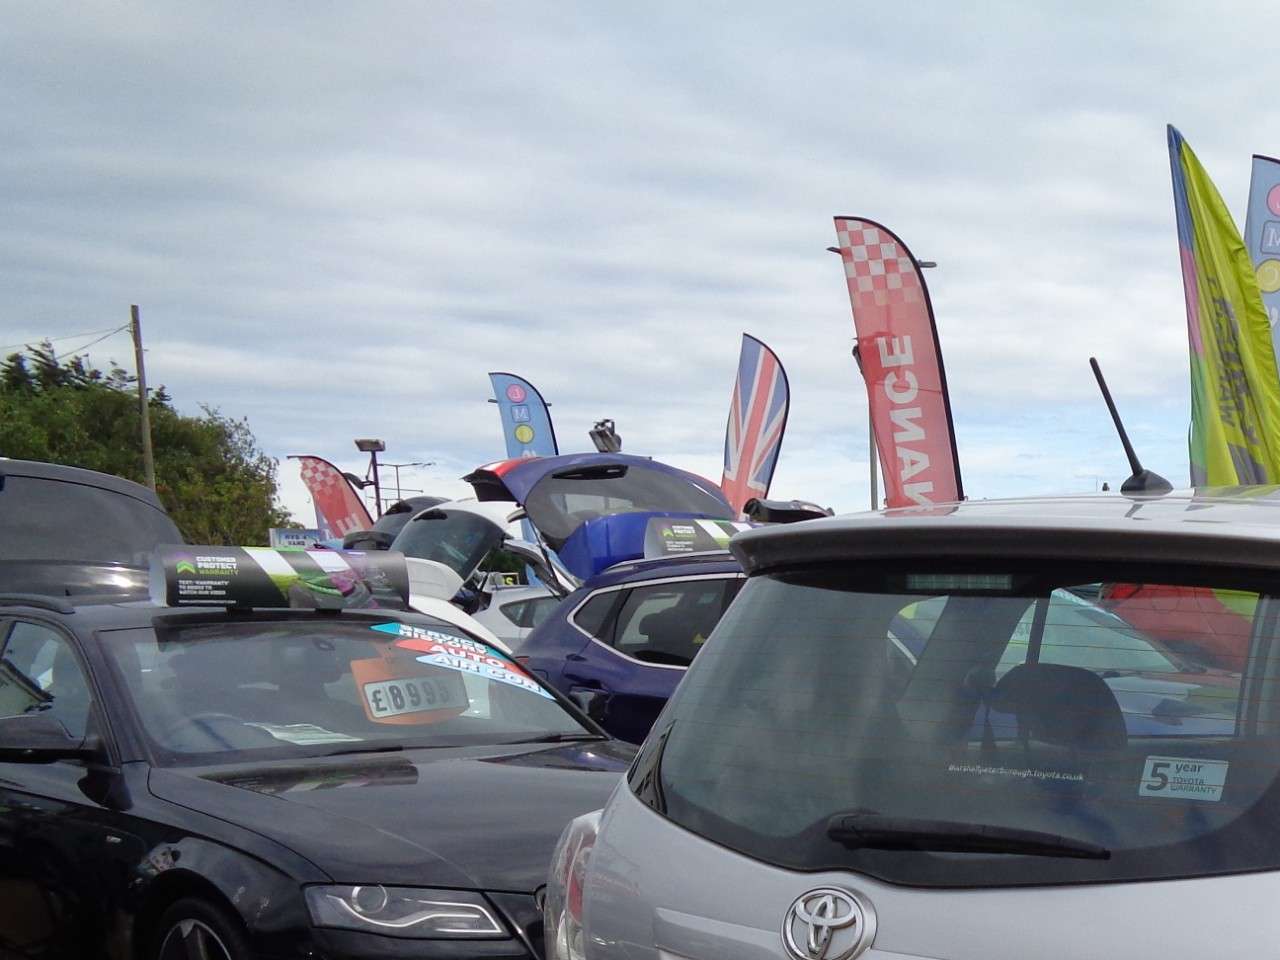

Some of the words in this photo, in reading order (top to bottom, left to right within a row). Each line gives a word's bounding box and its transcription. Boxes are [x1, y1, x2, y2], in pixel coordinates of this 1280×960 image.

[429, 644, 506, 669] AUTO
[434, 653, 481, 673] AIR
[1145, 762, 1170, 791] 5
[1175, 763, 1205, 774] year
